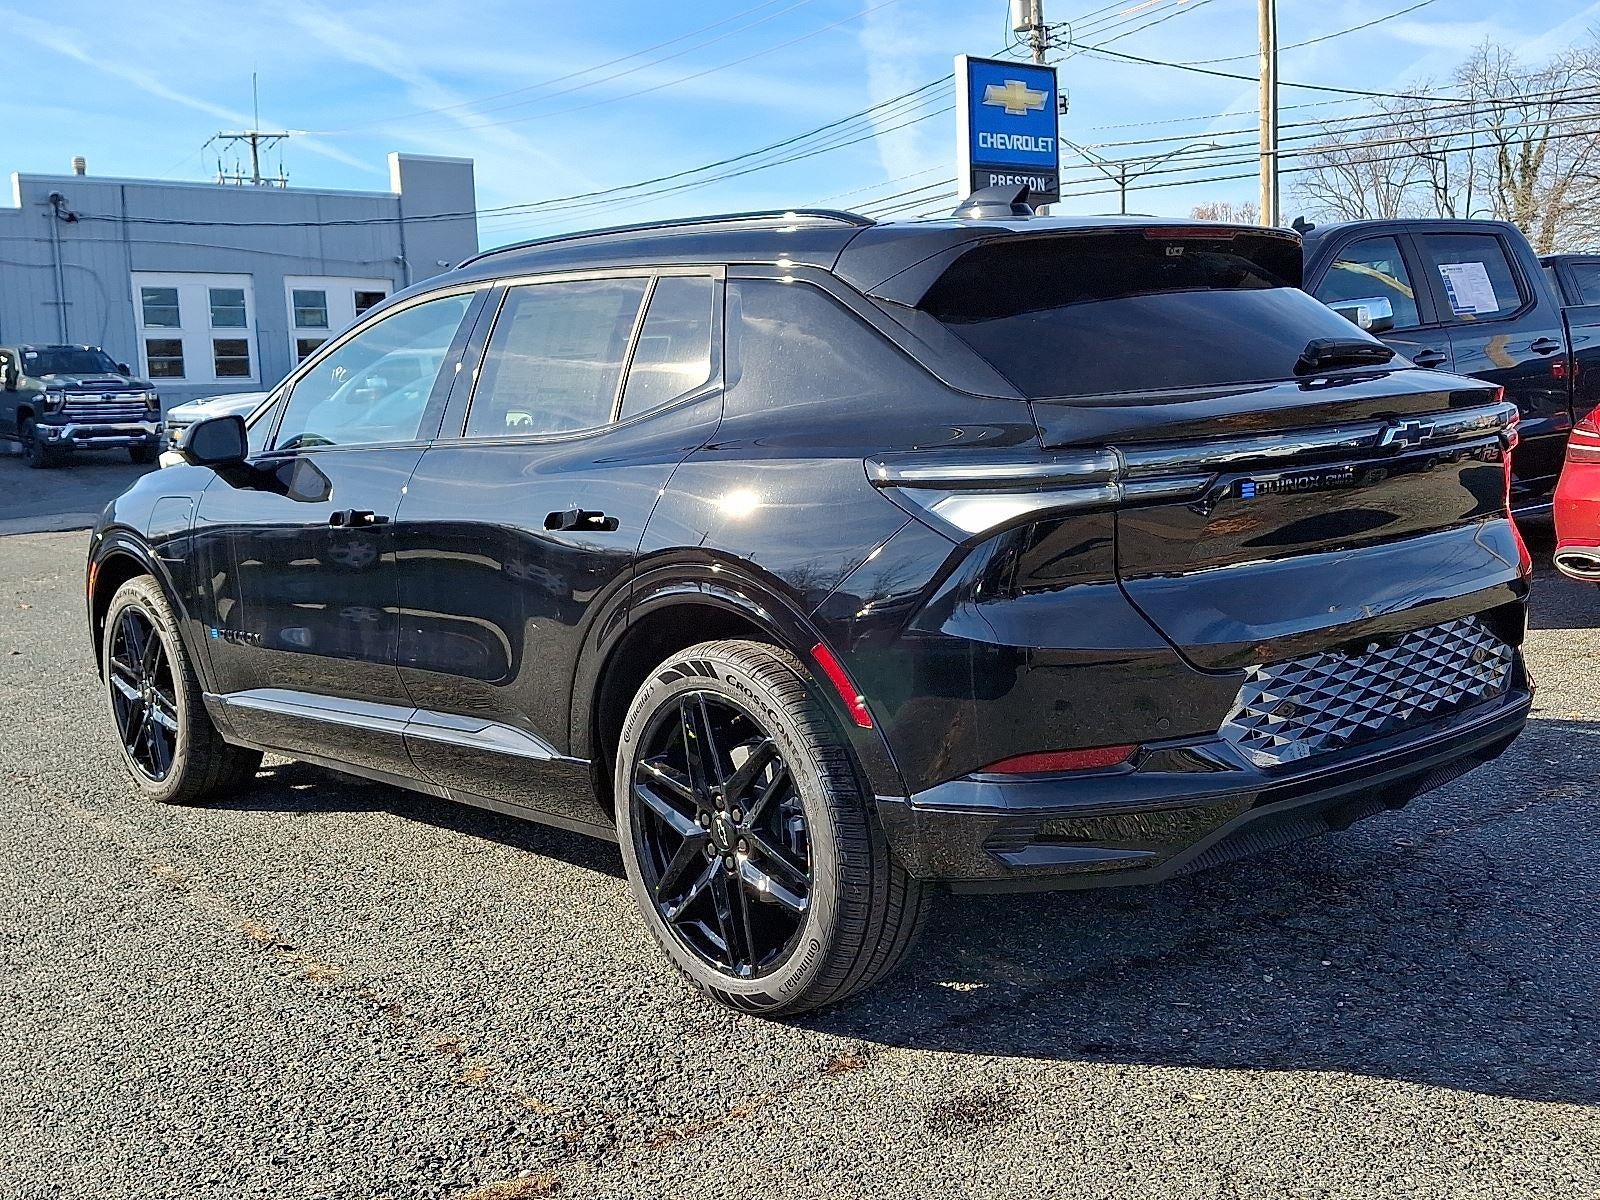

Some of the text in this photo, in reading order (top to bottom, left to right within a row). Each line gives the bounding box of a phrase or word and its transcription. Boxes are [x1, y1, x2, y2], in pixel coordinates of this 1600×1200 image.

[978, 132, 1054, 153] CHEVROLET
[989, 174, 1046, 192] PRESTON
[782, 937, 821, 993] Continental
